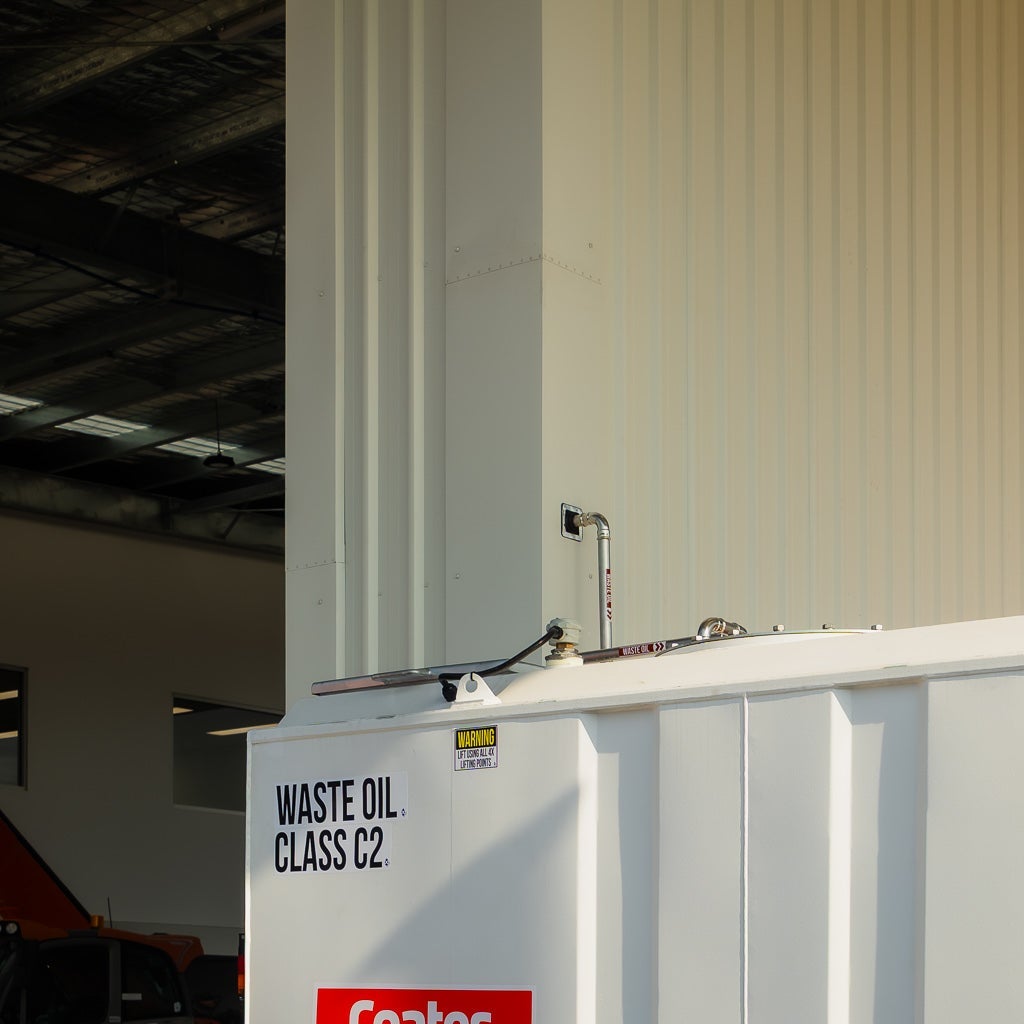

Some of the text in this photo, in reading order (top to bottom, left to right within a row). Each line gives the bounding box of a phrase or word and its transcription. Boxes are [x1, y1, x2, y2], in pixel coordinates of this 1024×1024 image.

[623, 647, 640, 655] WASTE
[458, 728, 495, 747] WARNING
[458, 750, 466, 759] LIFT
[467, 749, 479, 758] USING
[461, 758, 491, 768] LIFTING POINTS
[276, 777, 397, 825] WASTE OIL
[275, 826, 384, 873] CLASS C2
